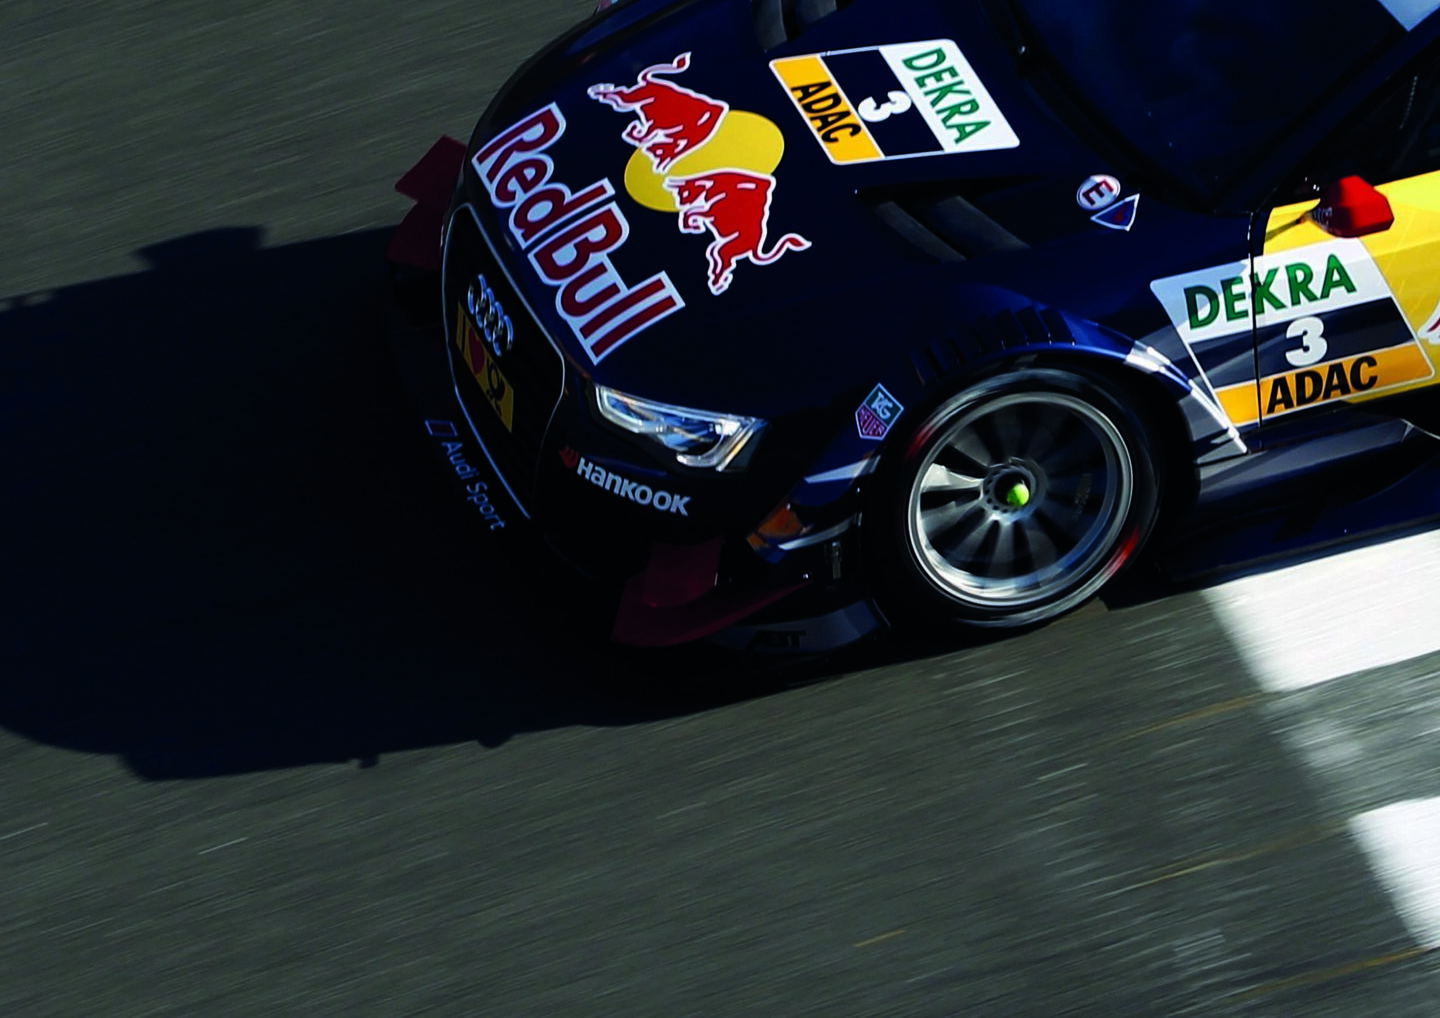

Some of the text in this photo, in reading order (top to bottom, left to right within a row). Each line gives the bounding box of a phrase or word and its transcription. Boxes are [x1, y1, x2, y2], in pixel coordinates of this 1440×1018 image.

[790, 80, 863, 143] ADAC
[857, 90, 912, 123] 3
[902, 47, 992, 145] DEKRA
[472, 102, 686, 366] Red Bull
[1183, 253, 1357, 331] DEKRA
[1284, 315, 1329, 367] 3
[1266, 356, 1379, 415] ADAC
[441, 441, 506, 531] Audi Sport
